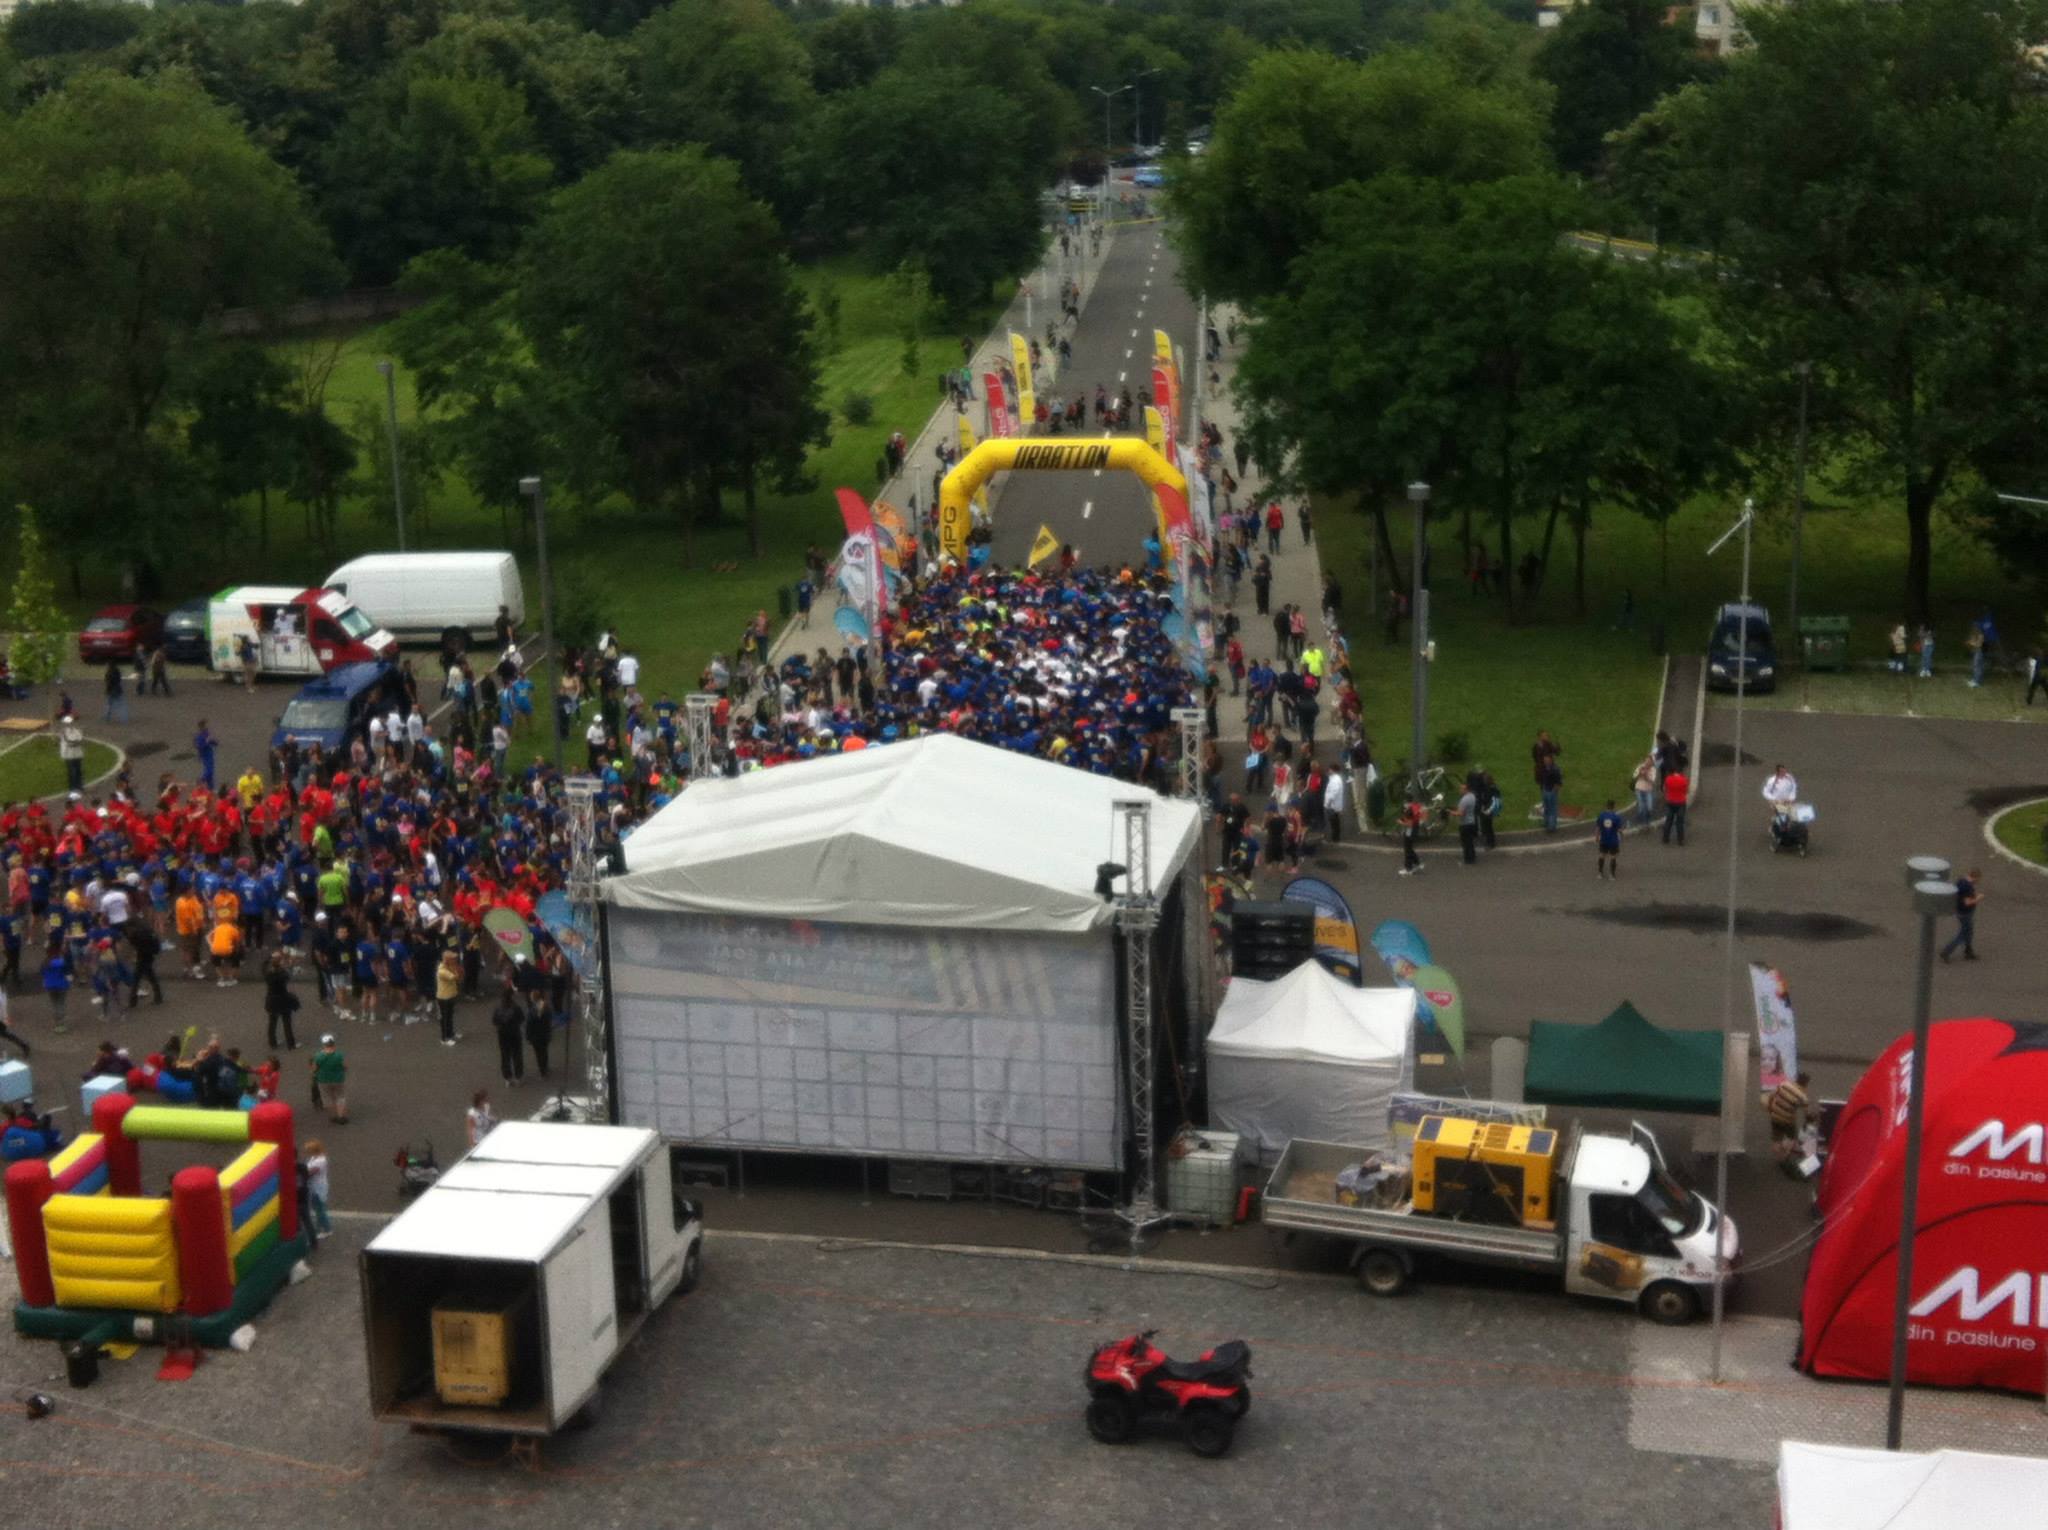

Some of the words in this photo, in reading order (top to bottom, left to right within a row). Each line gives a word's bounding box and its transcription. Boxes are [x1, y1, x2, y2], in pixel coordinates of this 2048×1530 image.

[1944, 1162, 1971, 1176] din
[1979, 1166, 2046, 1183] pasiune
[1946, 1331, 2037, 1352] pasiune
